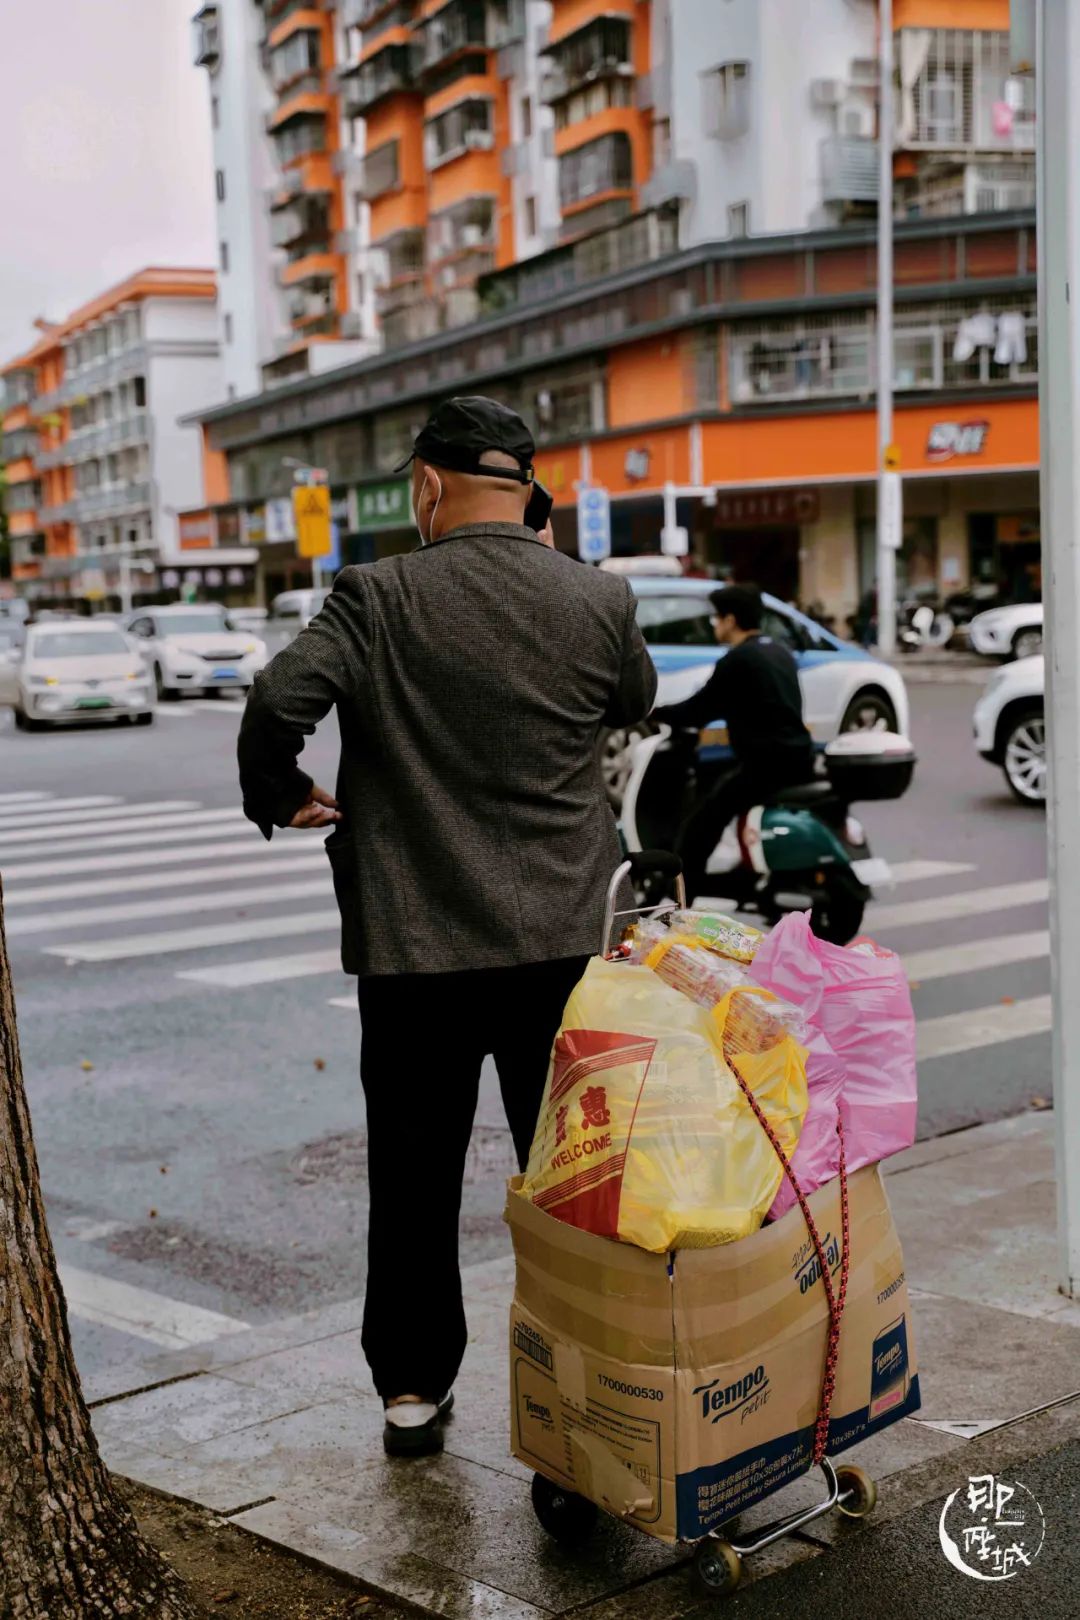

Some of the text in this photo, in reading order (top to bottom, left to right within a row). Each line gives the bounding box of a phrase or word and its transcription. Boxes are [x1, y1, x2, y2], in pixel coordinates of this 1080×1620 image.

[551, 1132, 612, 1170] WELCOME
[874, 1342, 901, 1372] Tempo
[598, 1374, 664, 1402] 1700000530
[692, 1365, 767, 1419] Tempo
[523, 1394, 551, 1418] Tempo
[740, 1388, 772, 1426] petit
[699, 1507, 724, 1526] Tempo
